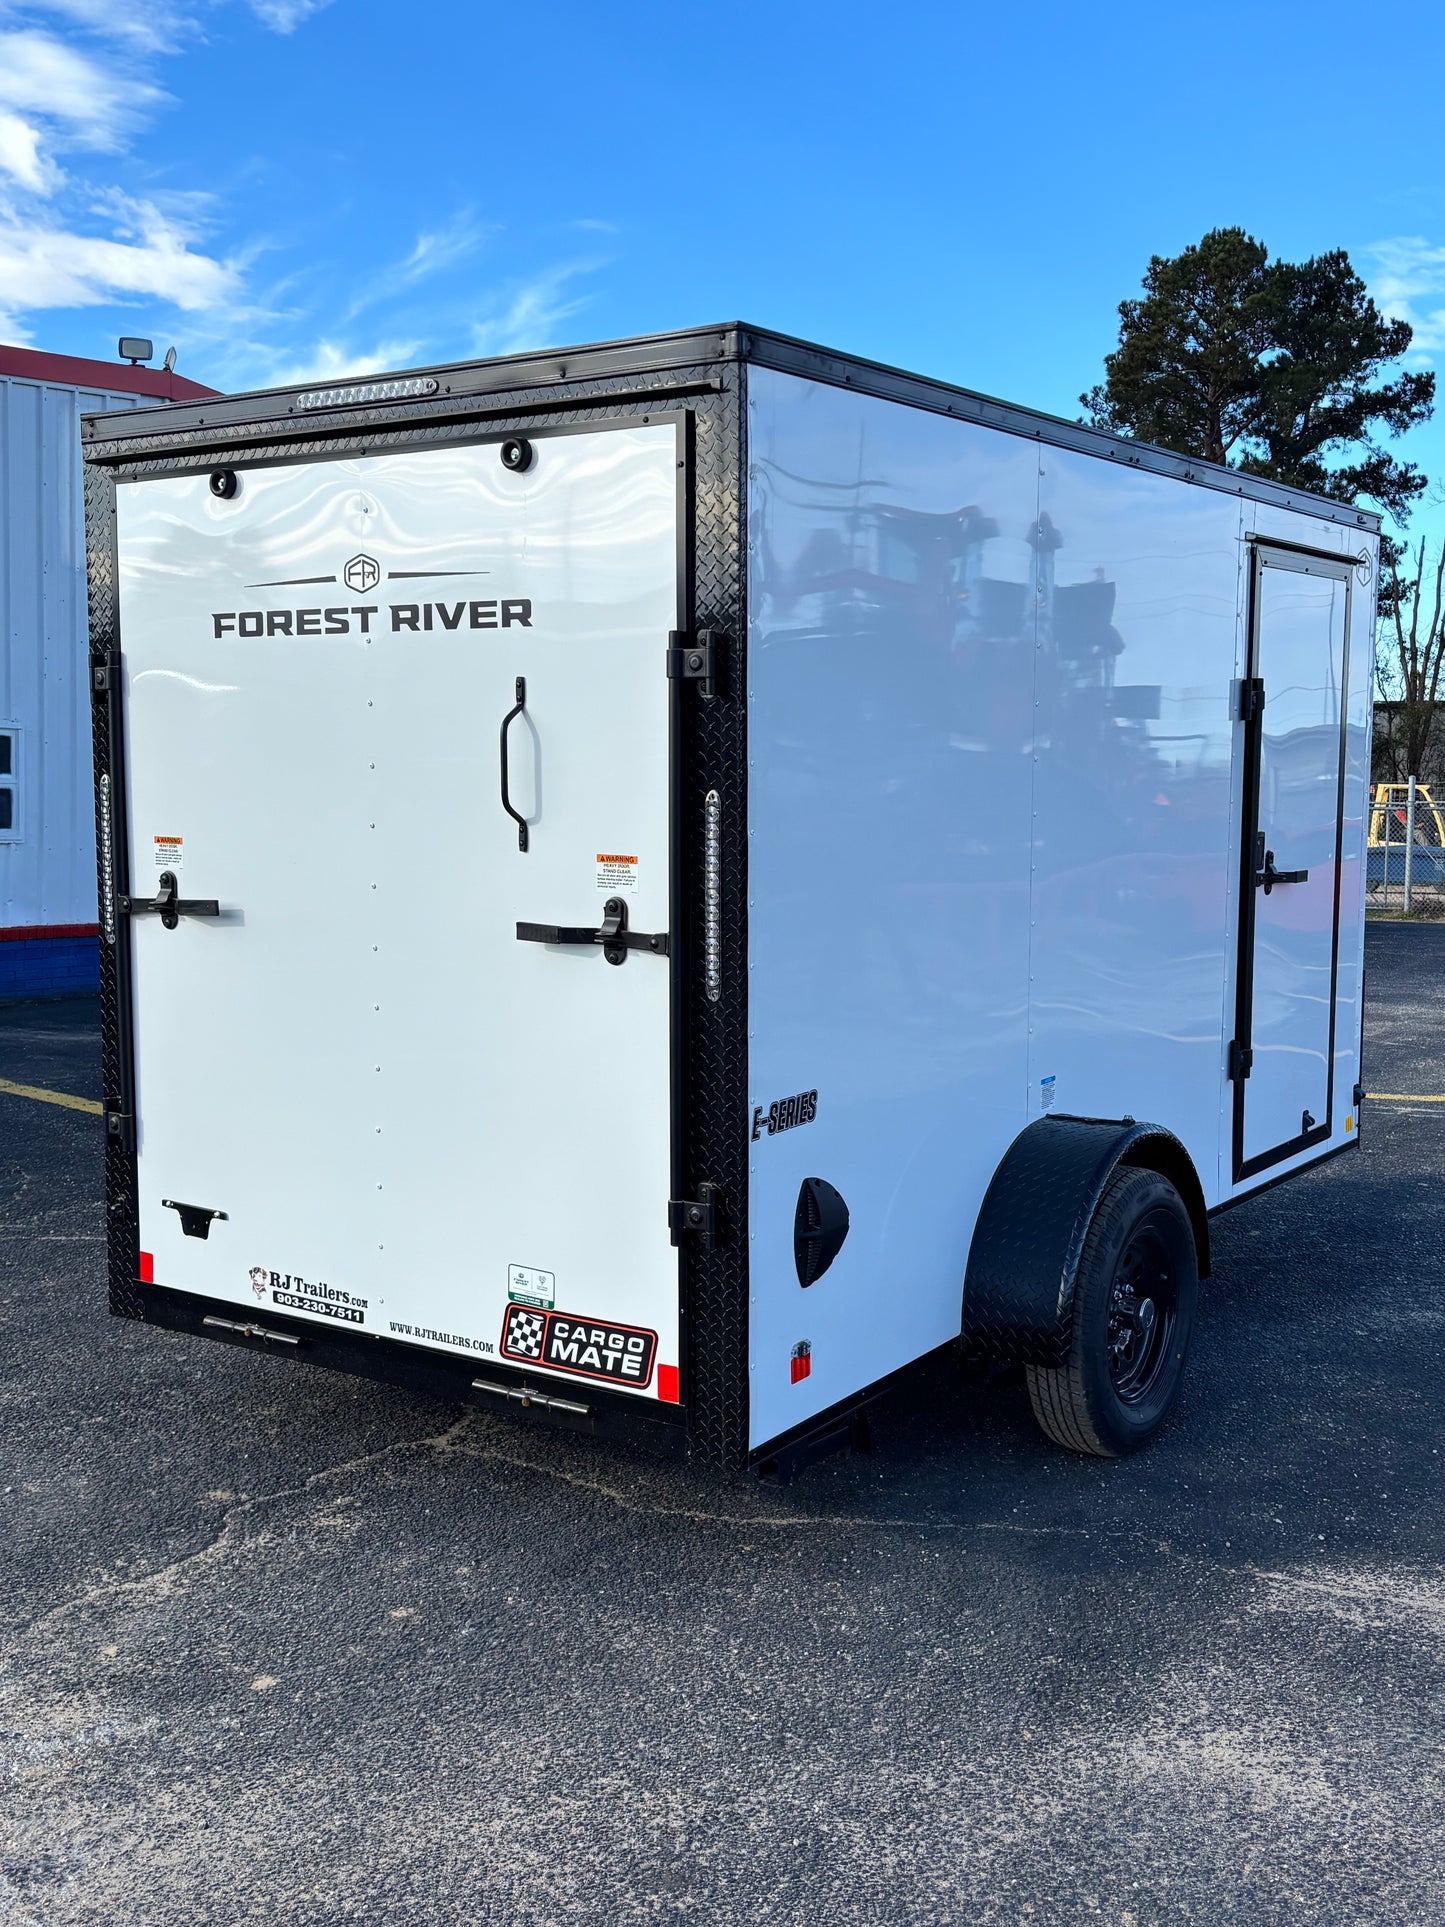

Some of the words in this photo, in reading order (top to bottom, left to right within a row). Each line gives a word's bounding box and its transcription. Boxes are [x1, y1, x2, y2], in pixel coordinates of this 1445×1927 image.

[211, 606, 379, 639] FOREST
[388, 599, 533, 632] RIVER
[605, 855, 635, 863] WARNING
[751, 1088, 818, 1142] E-SERIES
[269, 1270, 292, 1290] RJ
[276, 1293, 361, 1322] 903-230-7511
[389, 1321, 494, 1354] WWW.RJTRAILERS.COM
[554, 1322, 645, 1353] CARGO
[550, 1338, 643, 1377] MATE
